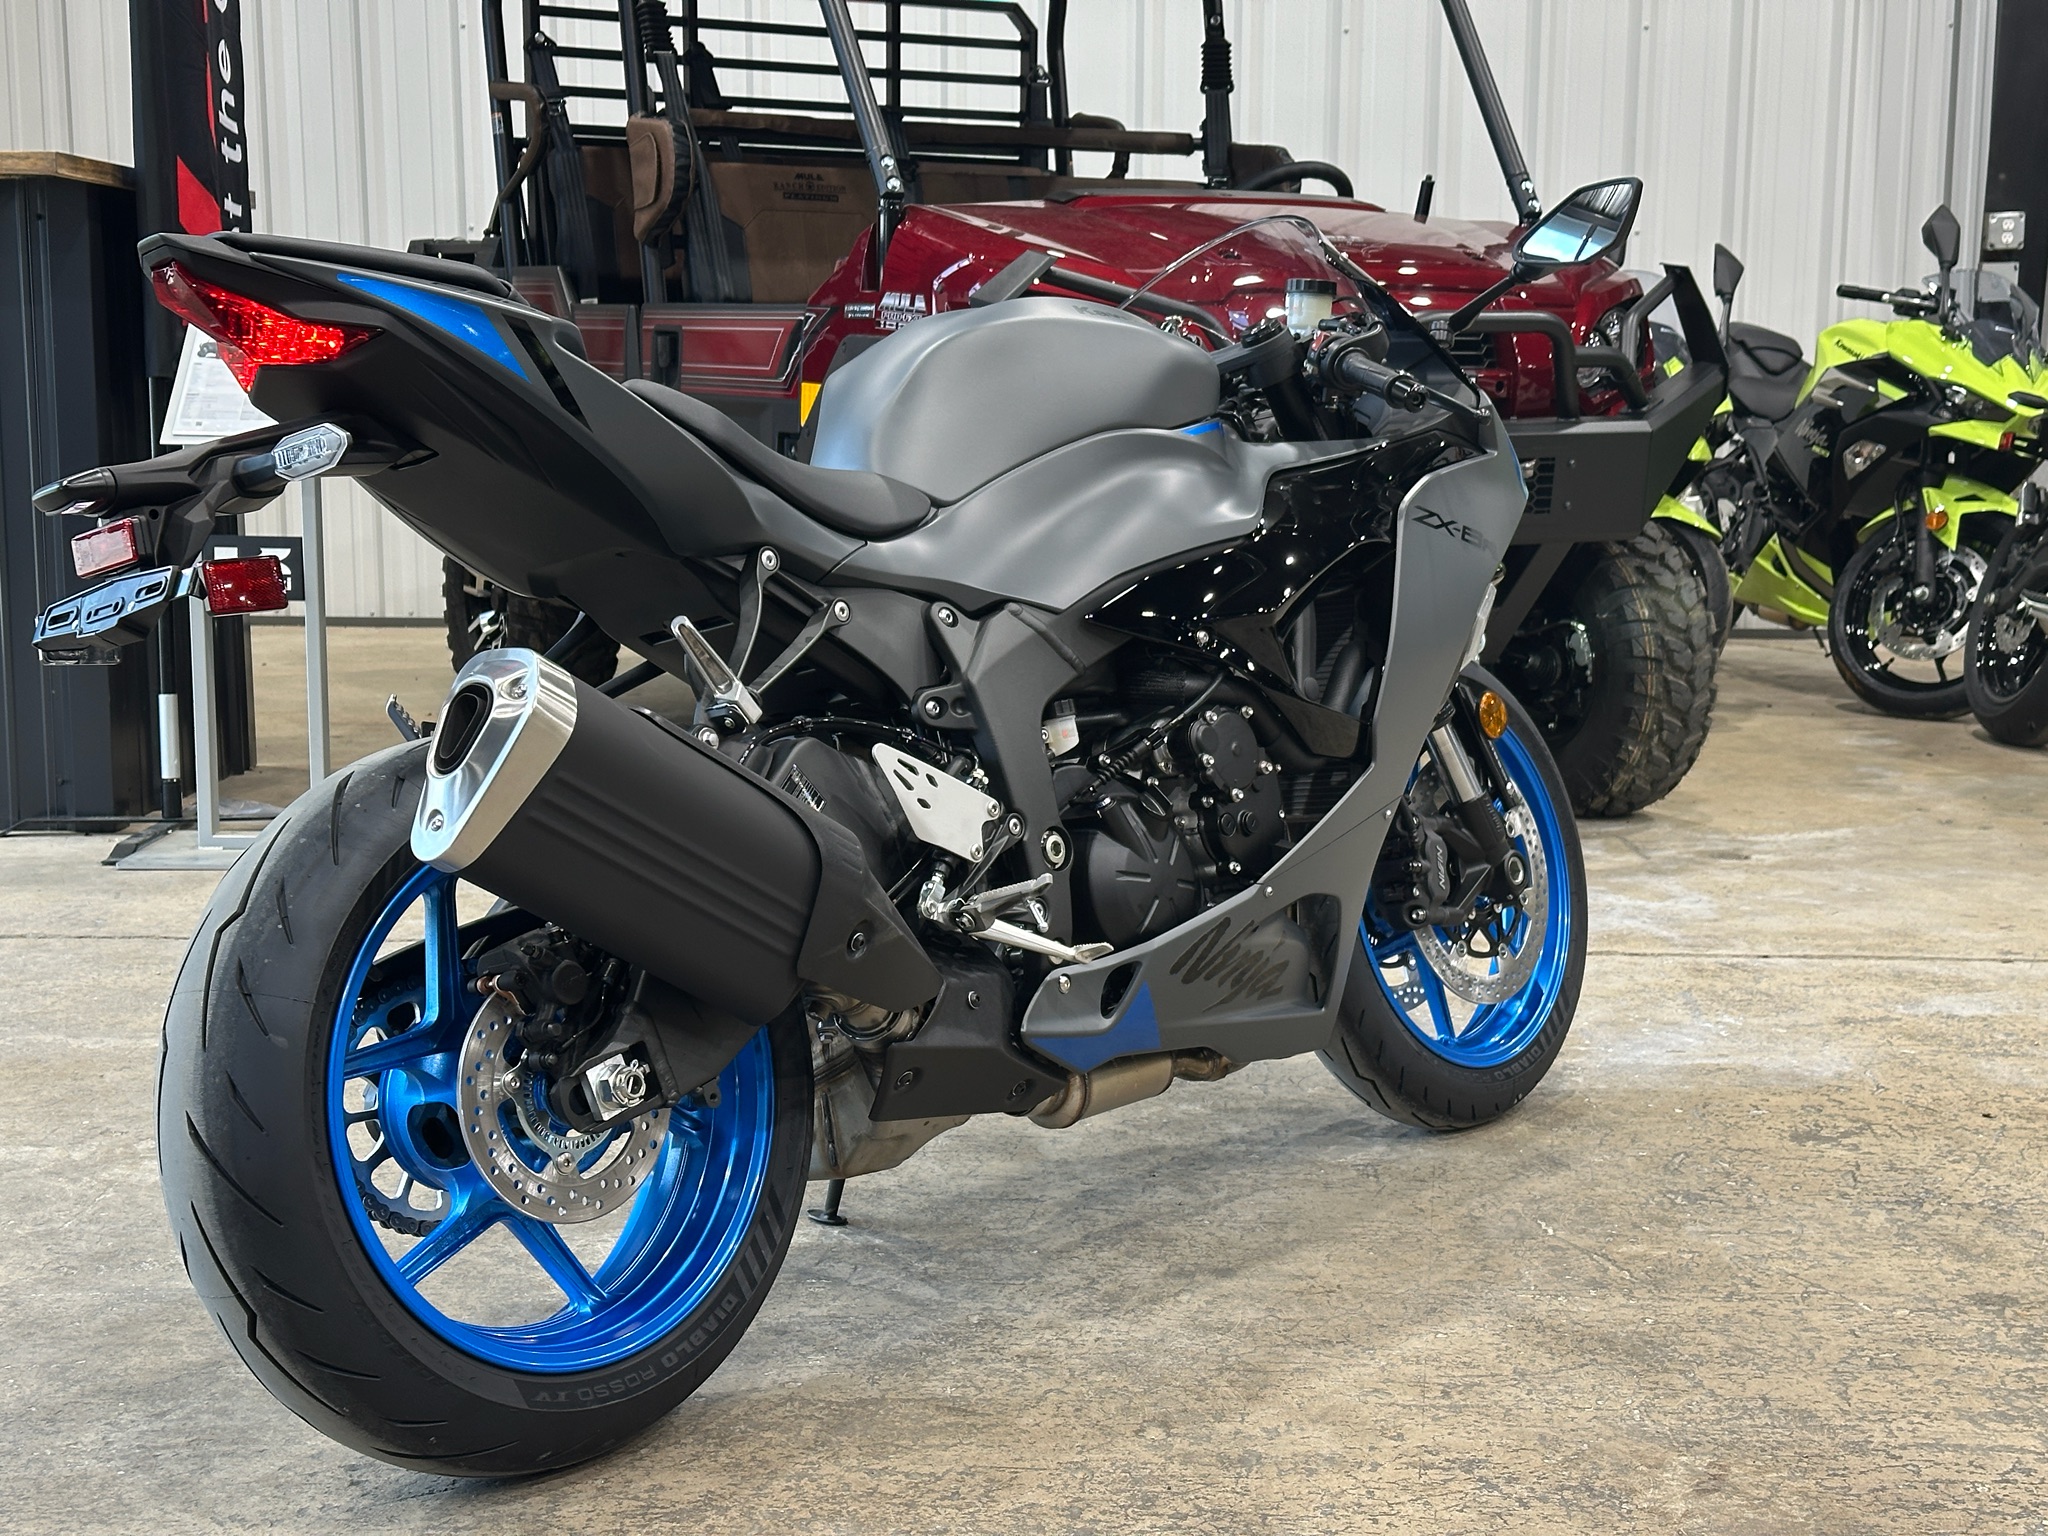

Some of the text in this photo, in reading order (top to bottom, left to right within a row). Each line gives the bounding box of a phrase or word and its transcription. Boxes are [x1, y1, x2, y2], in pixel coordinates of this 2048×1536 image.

[218, 38, 242, 163] the
[1169, 916, 1289, 1013] Ninja
[660, 1293, 741, 1369] DIABLO
[576, 1366, 657, 1402] ROSSO
